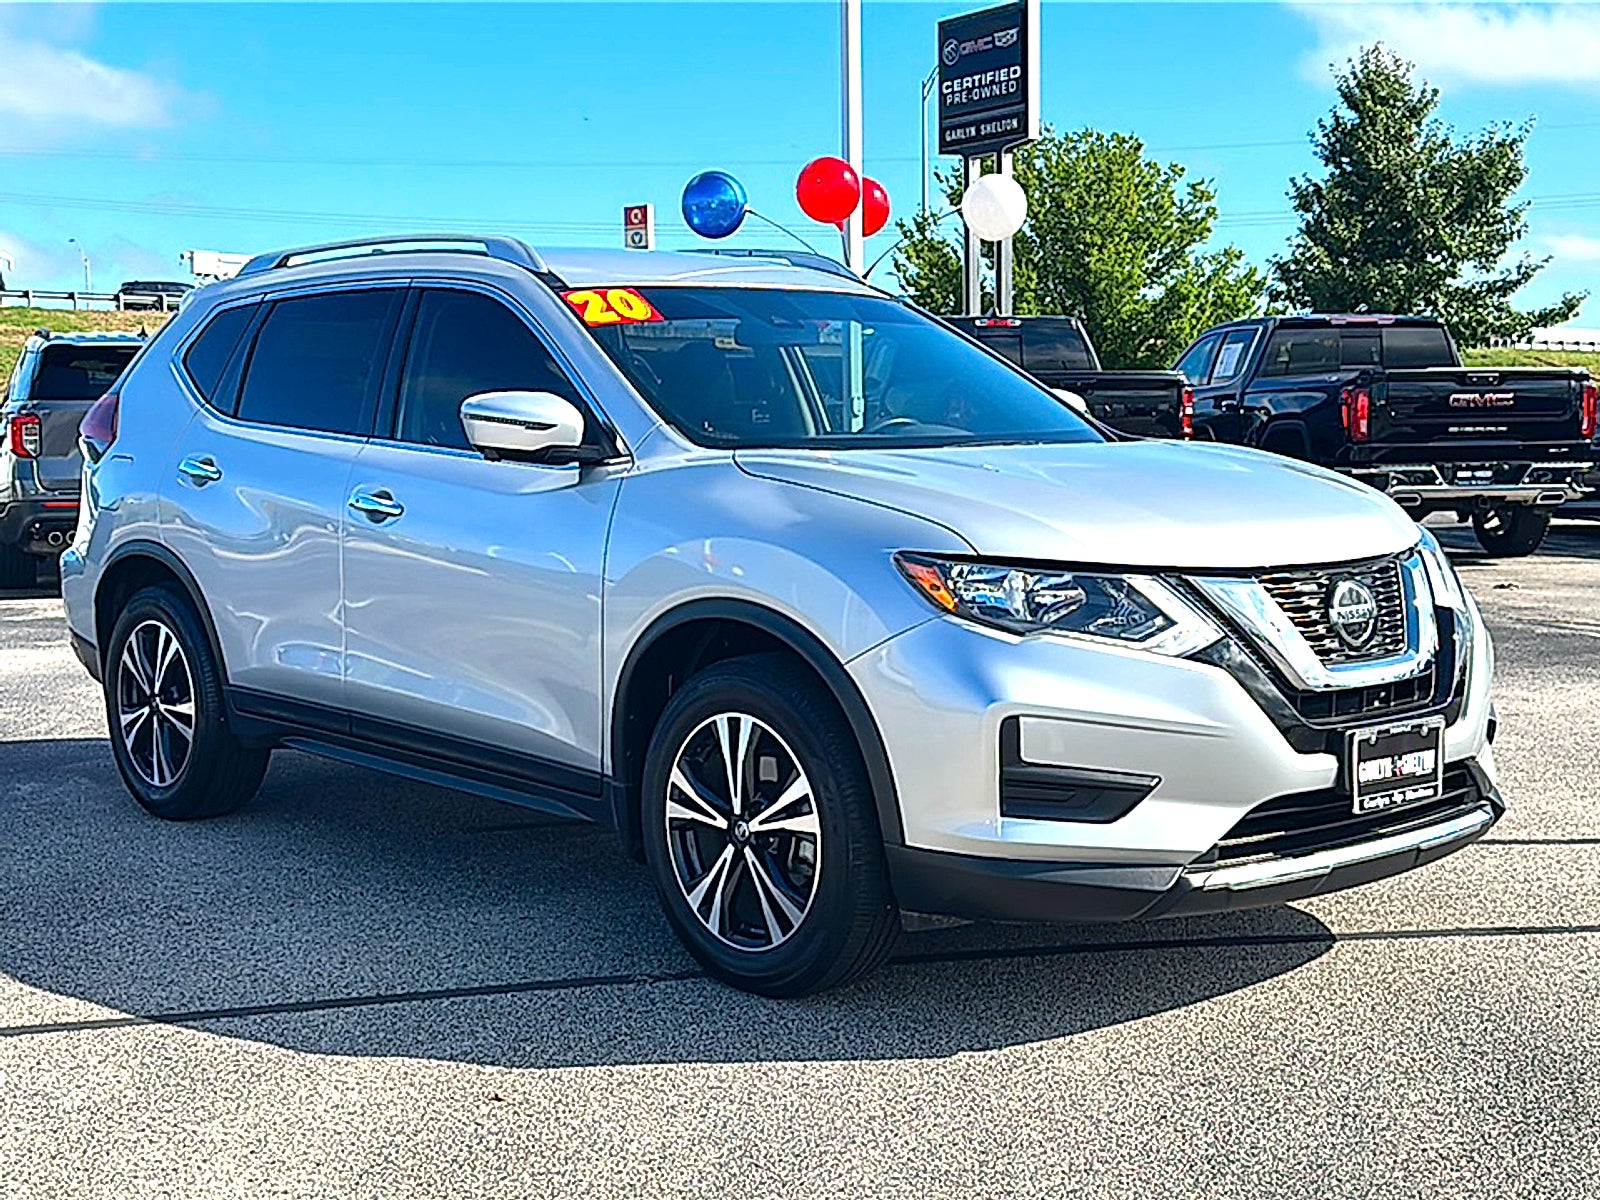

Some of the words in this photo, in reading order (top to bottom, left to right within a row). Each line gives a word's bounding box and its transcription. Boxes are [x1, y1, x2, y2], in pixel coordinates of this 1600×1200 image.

[942, 65, 1021, 94] CERTIFIED
[946, 80, 1017, 107] PRE-OWNED
[945, 125, 977, 142] GARLYN
[980, 118, 1018, 136] SHELTON
[567, 289, 651, 323] 20
[1449, 392, 1515, 407] GMC
[1336, 607, 1372, 621] NISSAN
